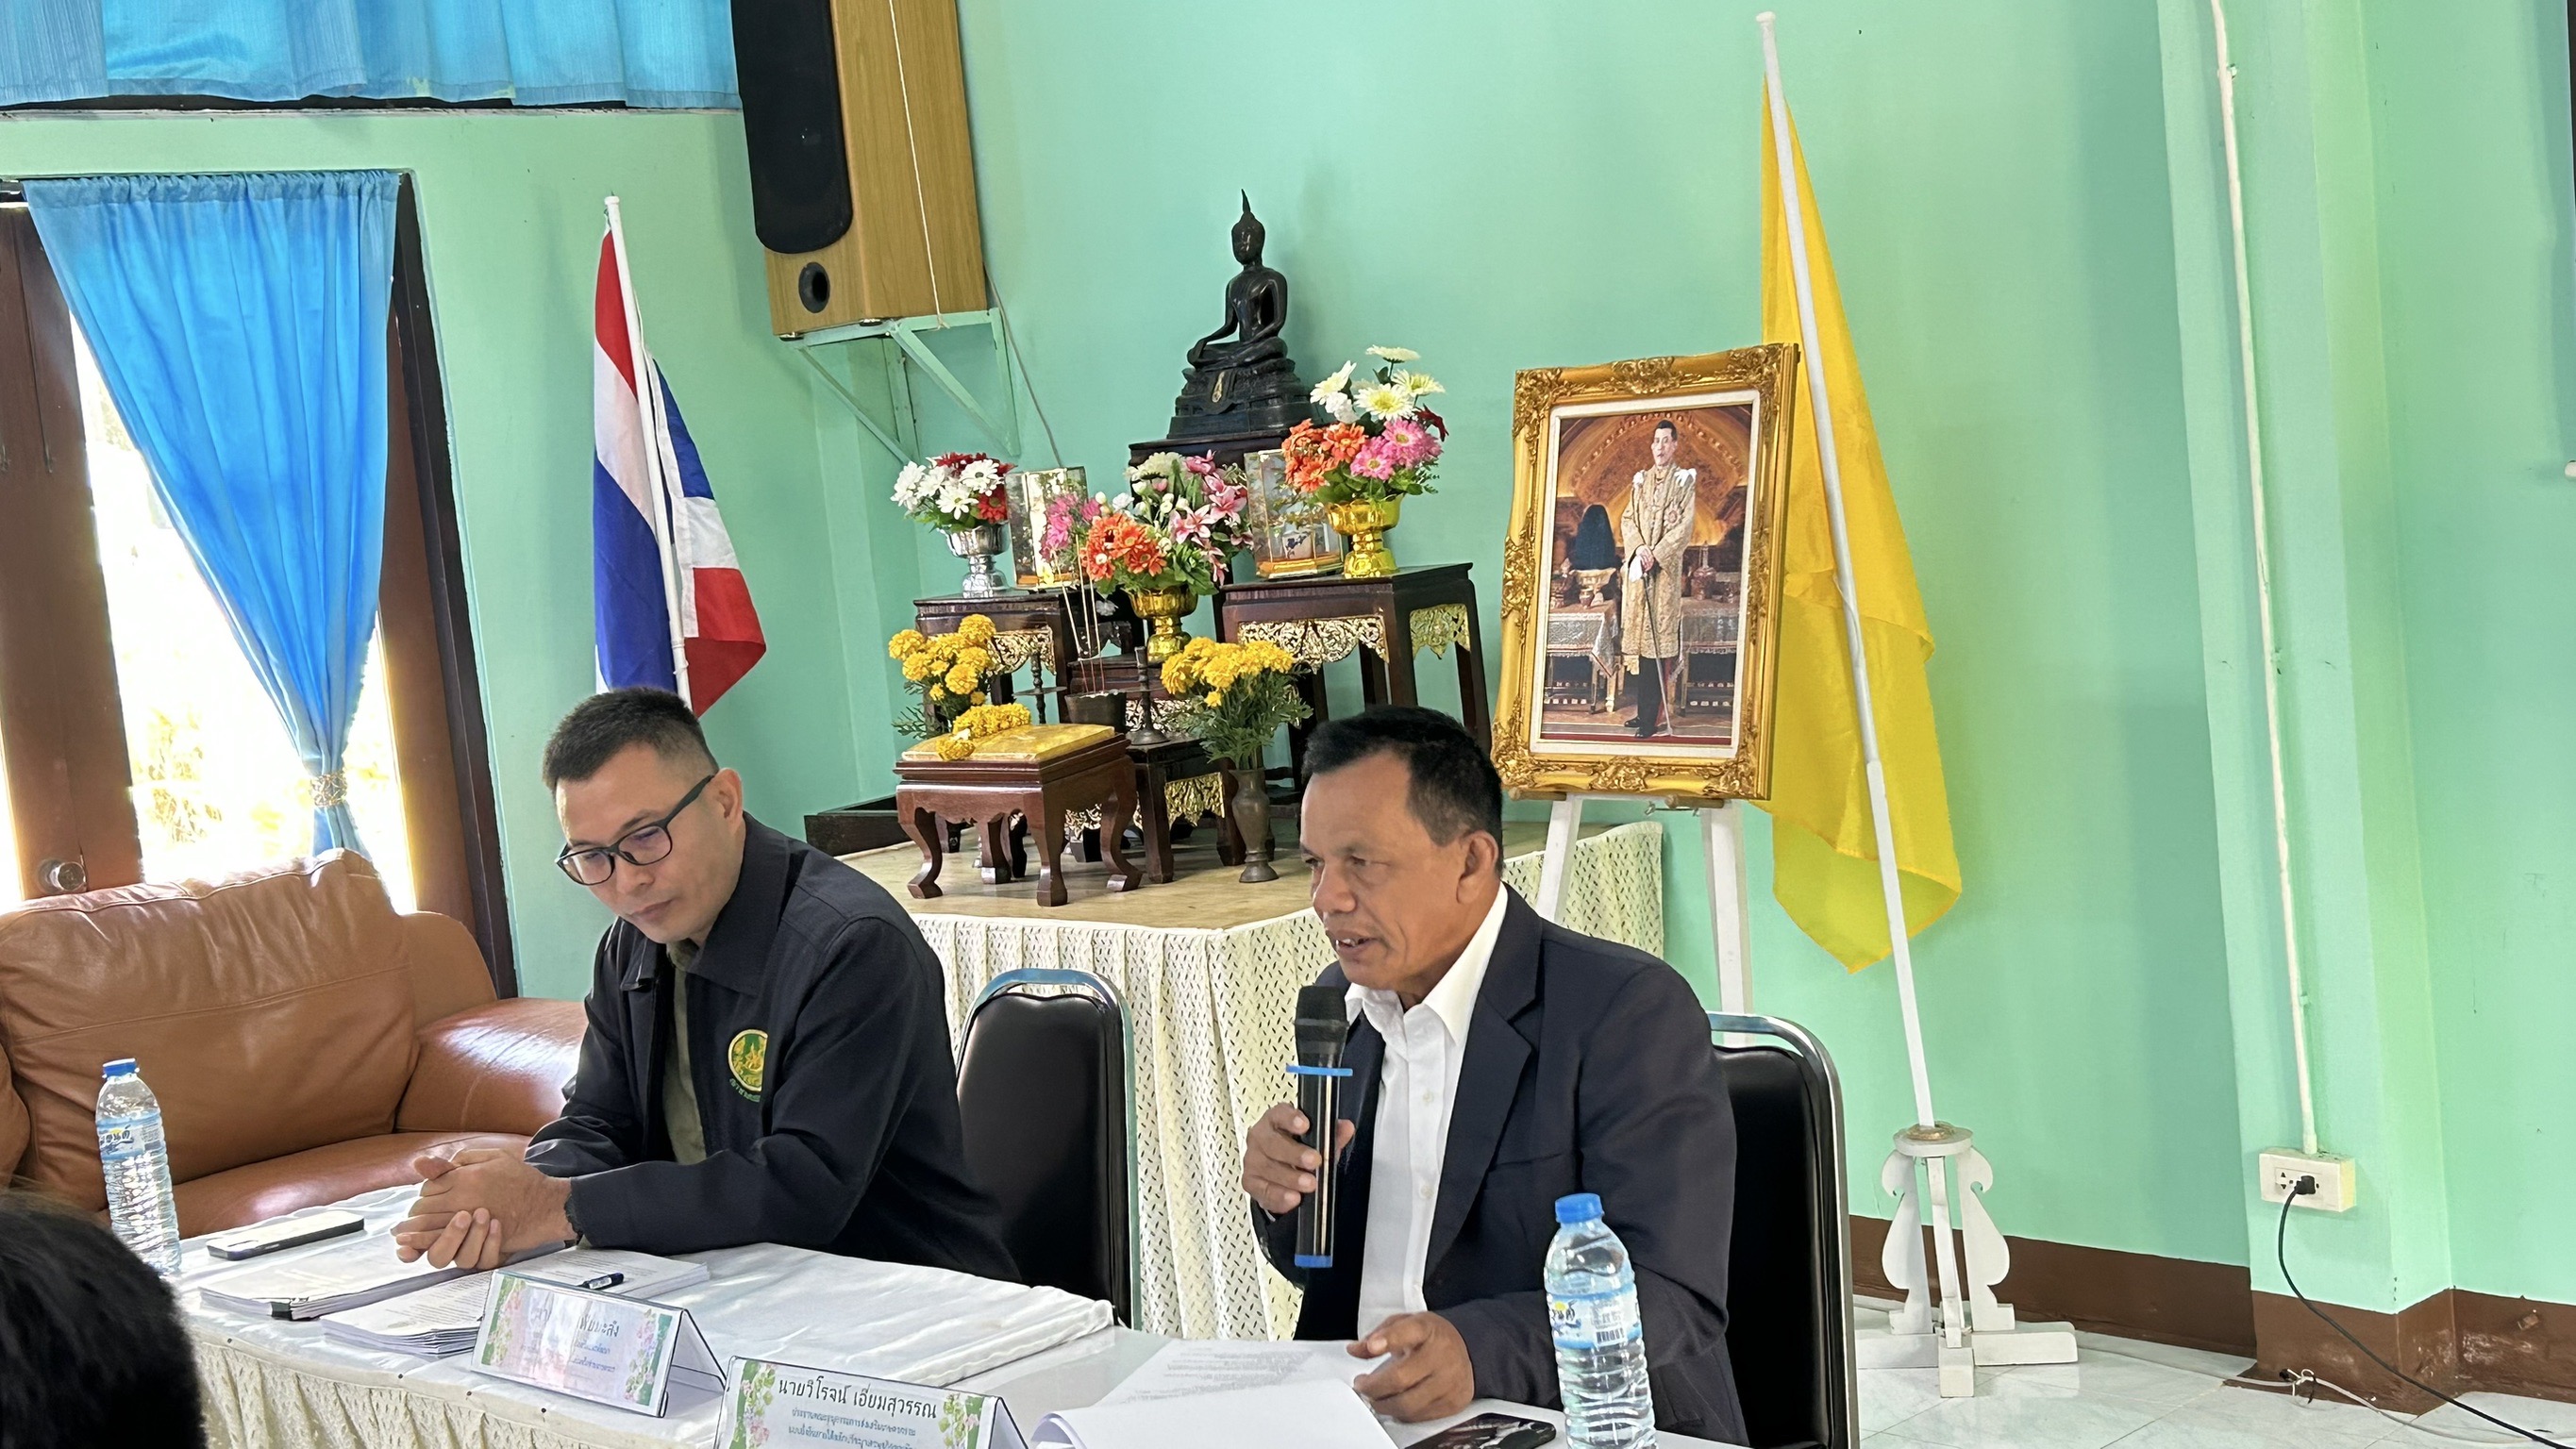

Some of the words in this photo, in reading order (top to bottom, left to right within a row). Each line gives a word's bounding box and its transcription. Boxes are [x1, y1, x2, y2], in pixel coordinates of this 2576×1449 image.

[778, 1375, 851, 1404] นายวิโรจน์
[853, 1383, 937, 1419] เอี่ยมสุวรรณ
